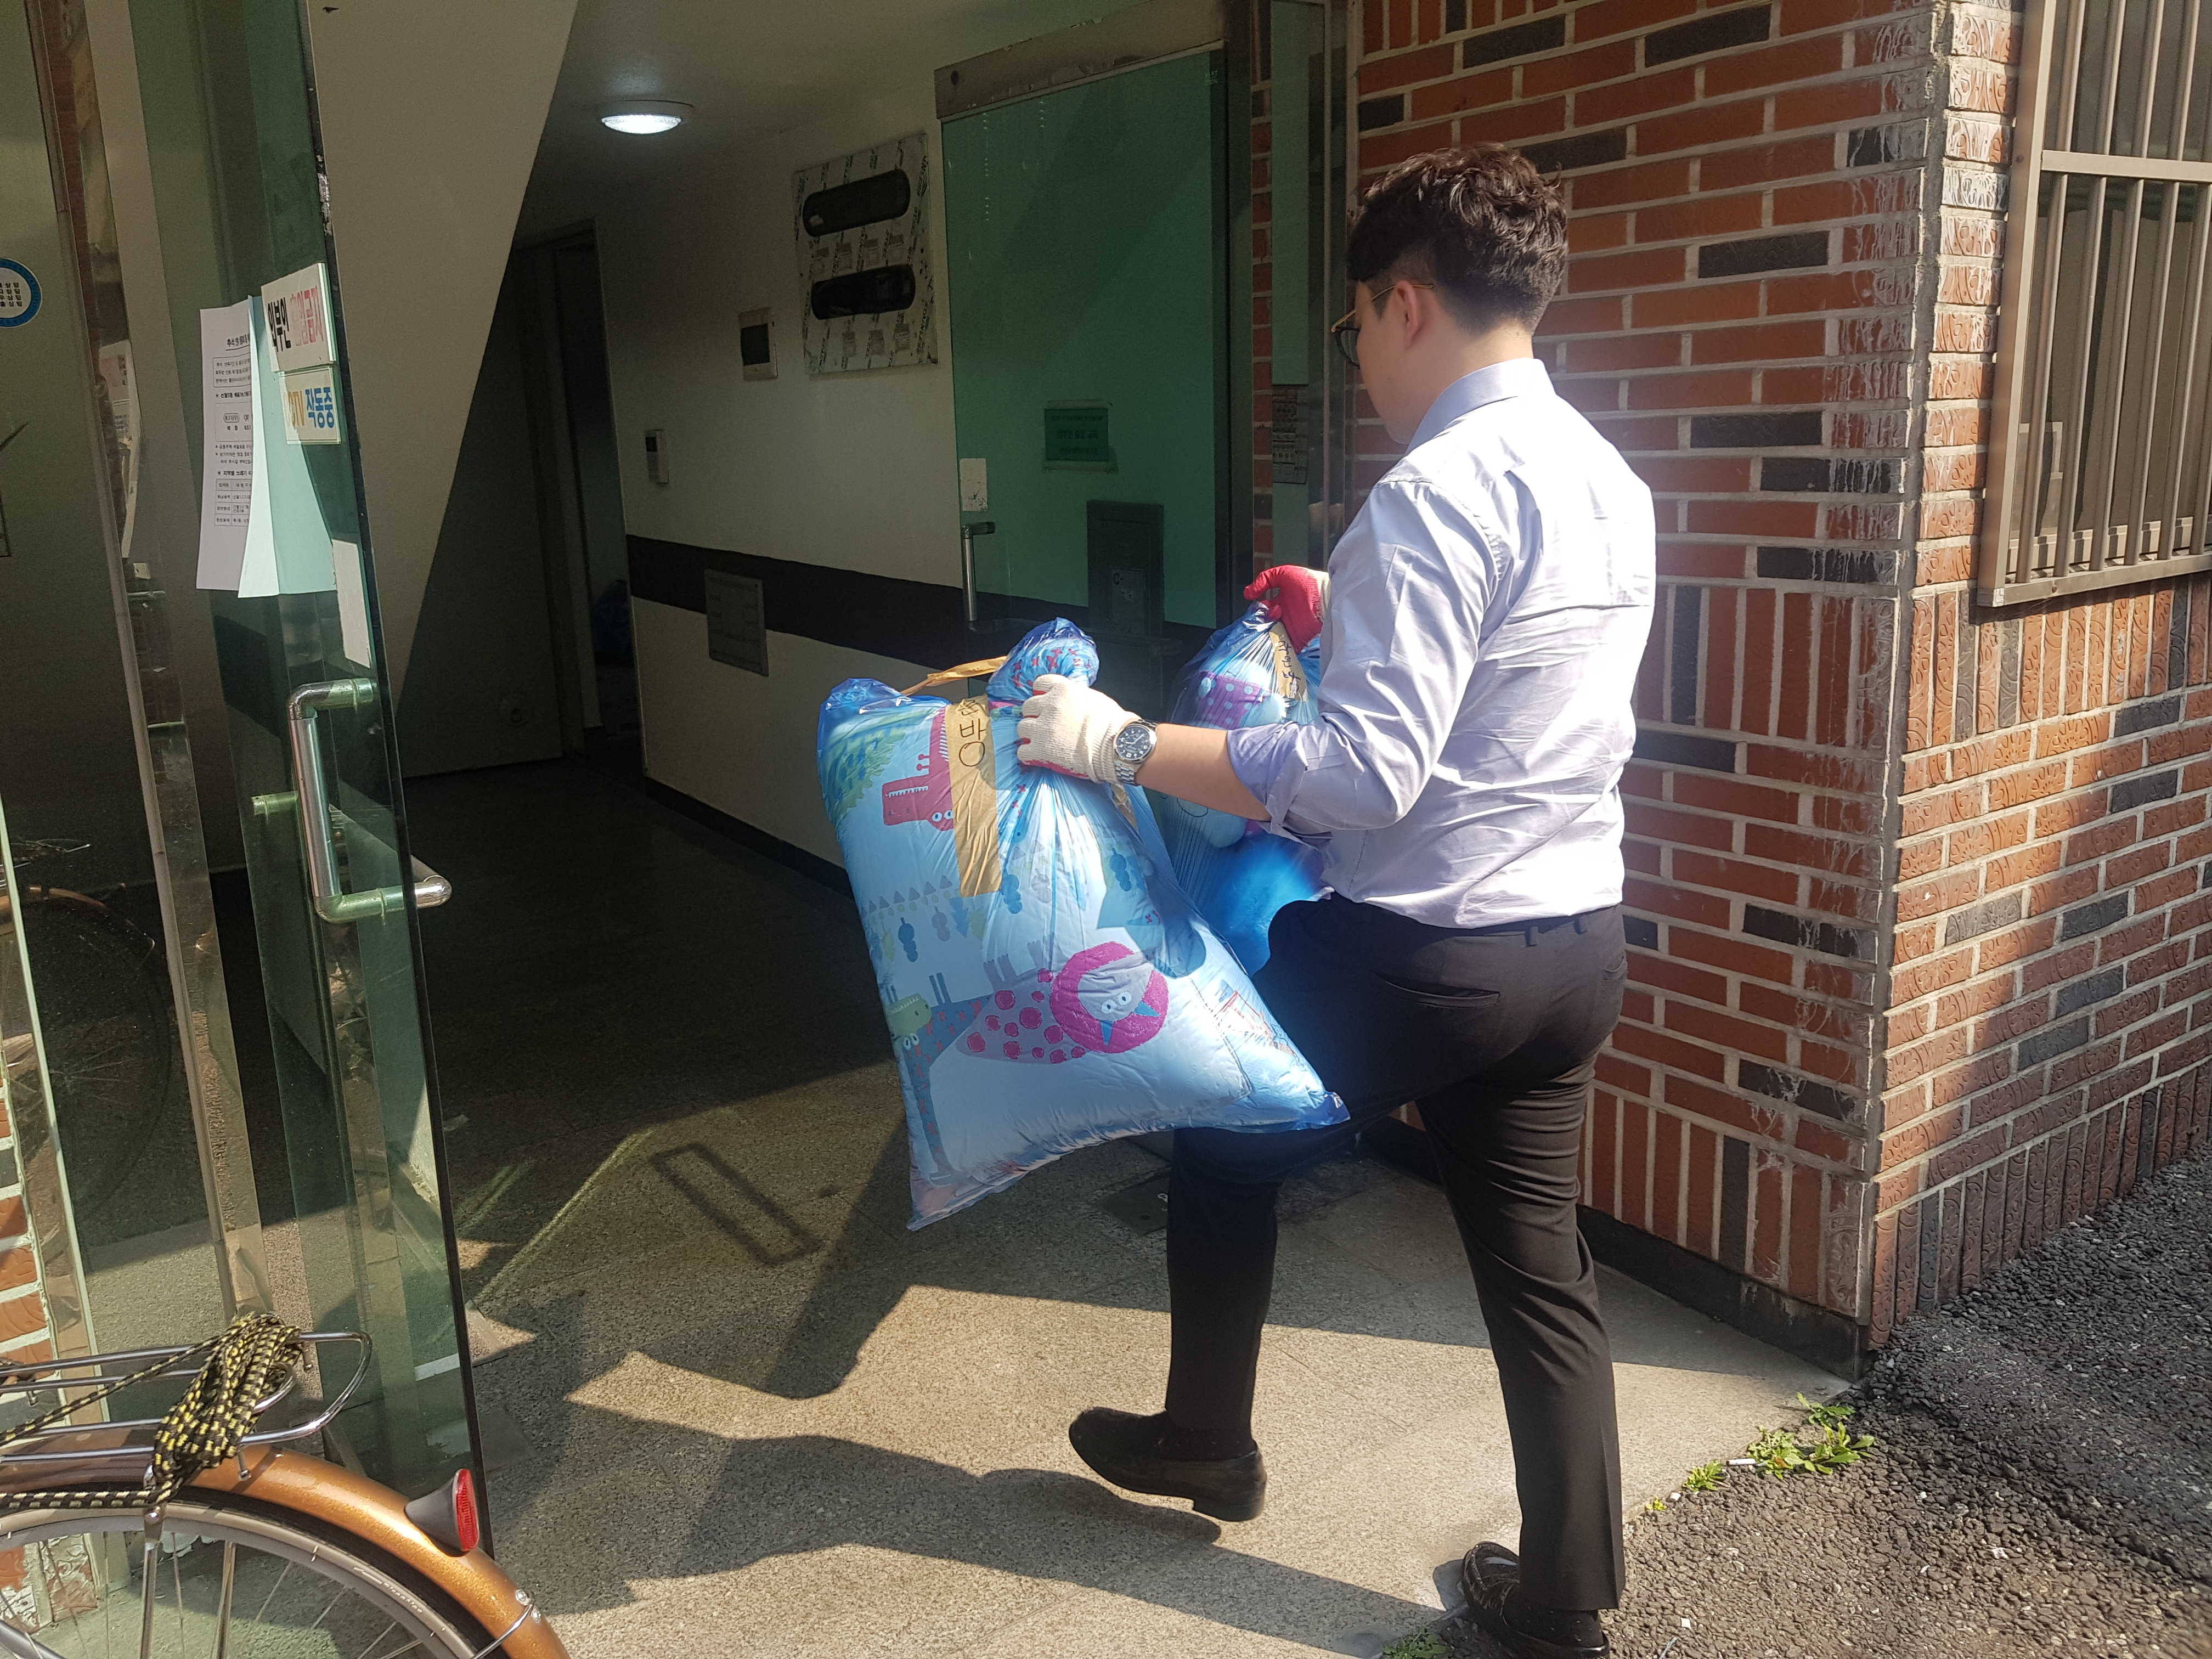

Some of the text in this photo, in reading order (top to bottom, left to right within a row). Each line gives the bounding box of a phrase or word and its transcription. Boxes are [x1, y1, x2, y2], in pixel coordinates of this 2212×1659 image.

[268, 285, 324, 352] 외부인 출입금지
[284, 387, 334, 428] CTV 작동중
